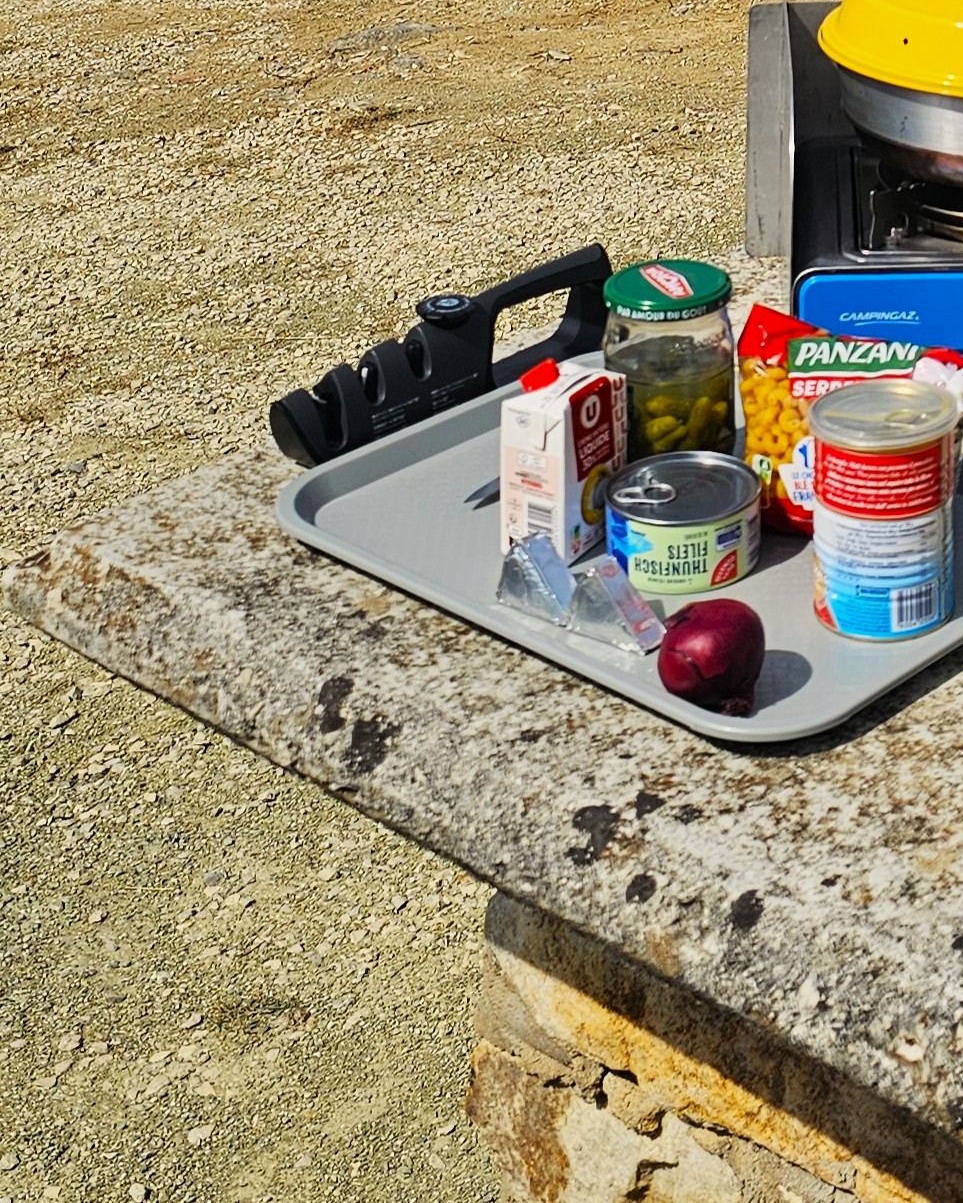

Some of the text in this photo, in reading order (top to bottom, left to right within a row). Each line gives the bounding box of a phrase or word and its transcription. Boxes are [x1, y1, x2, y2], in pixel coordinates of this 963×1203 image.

[616, 304, 632, 318] PAR
[631, 309, 666, 322] AMOUR
[666, 310, 681, 321] DU
[839, 310, 920, 322] CAMPINGAZ
[794, 341, 920, 367] PANZANI
[579, 429, 611, 459] LIQUIDE
[666, 540, 708, 560] FILETS
[634, 556, 708, 577] THUNFISCH
